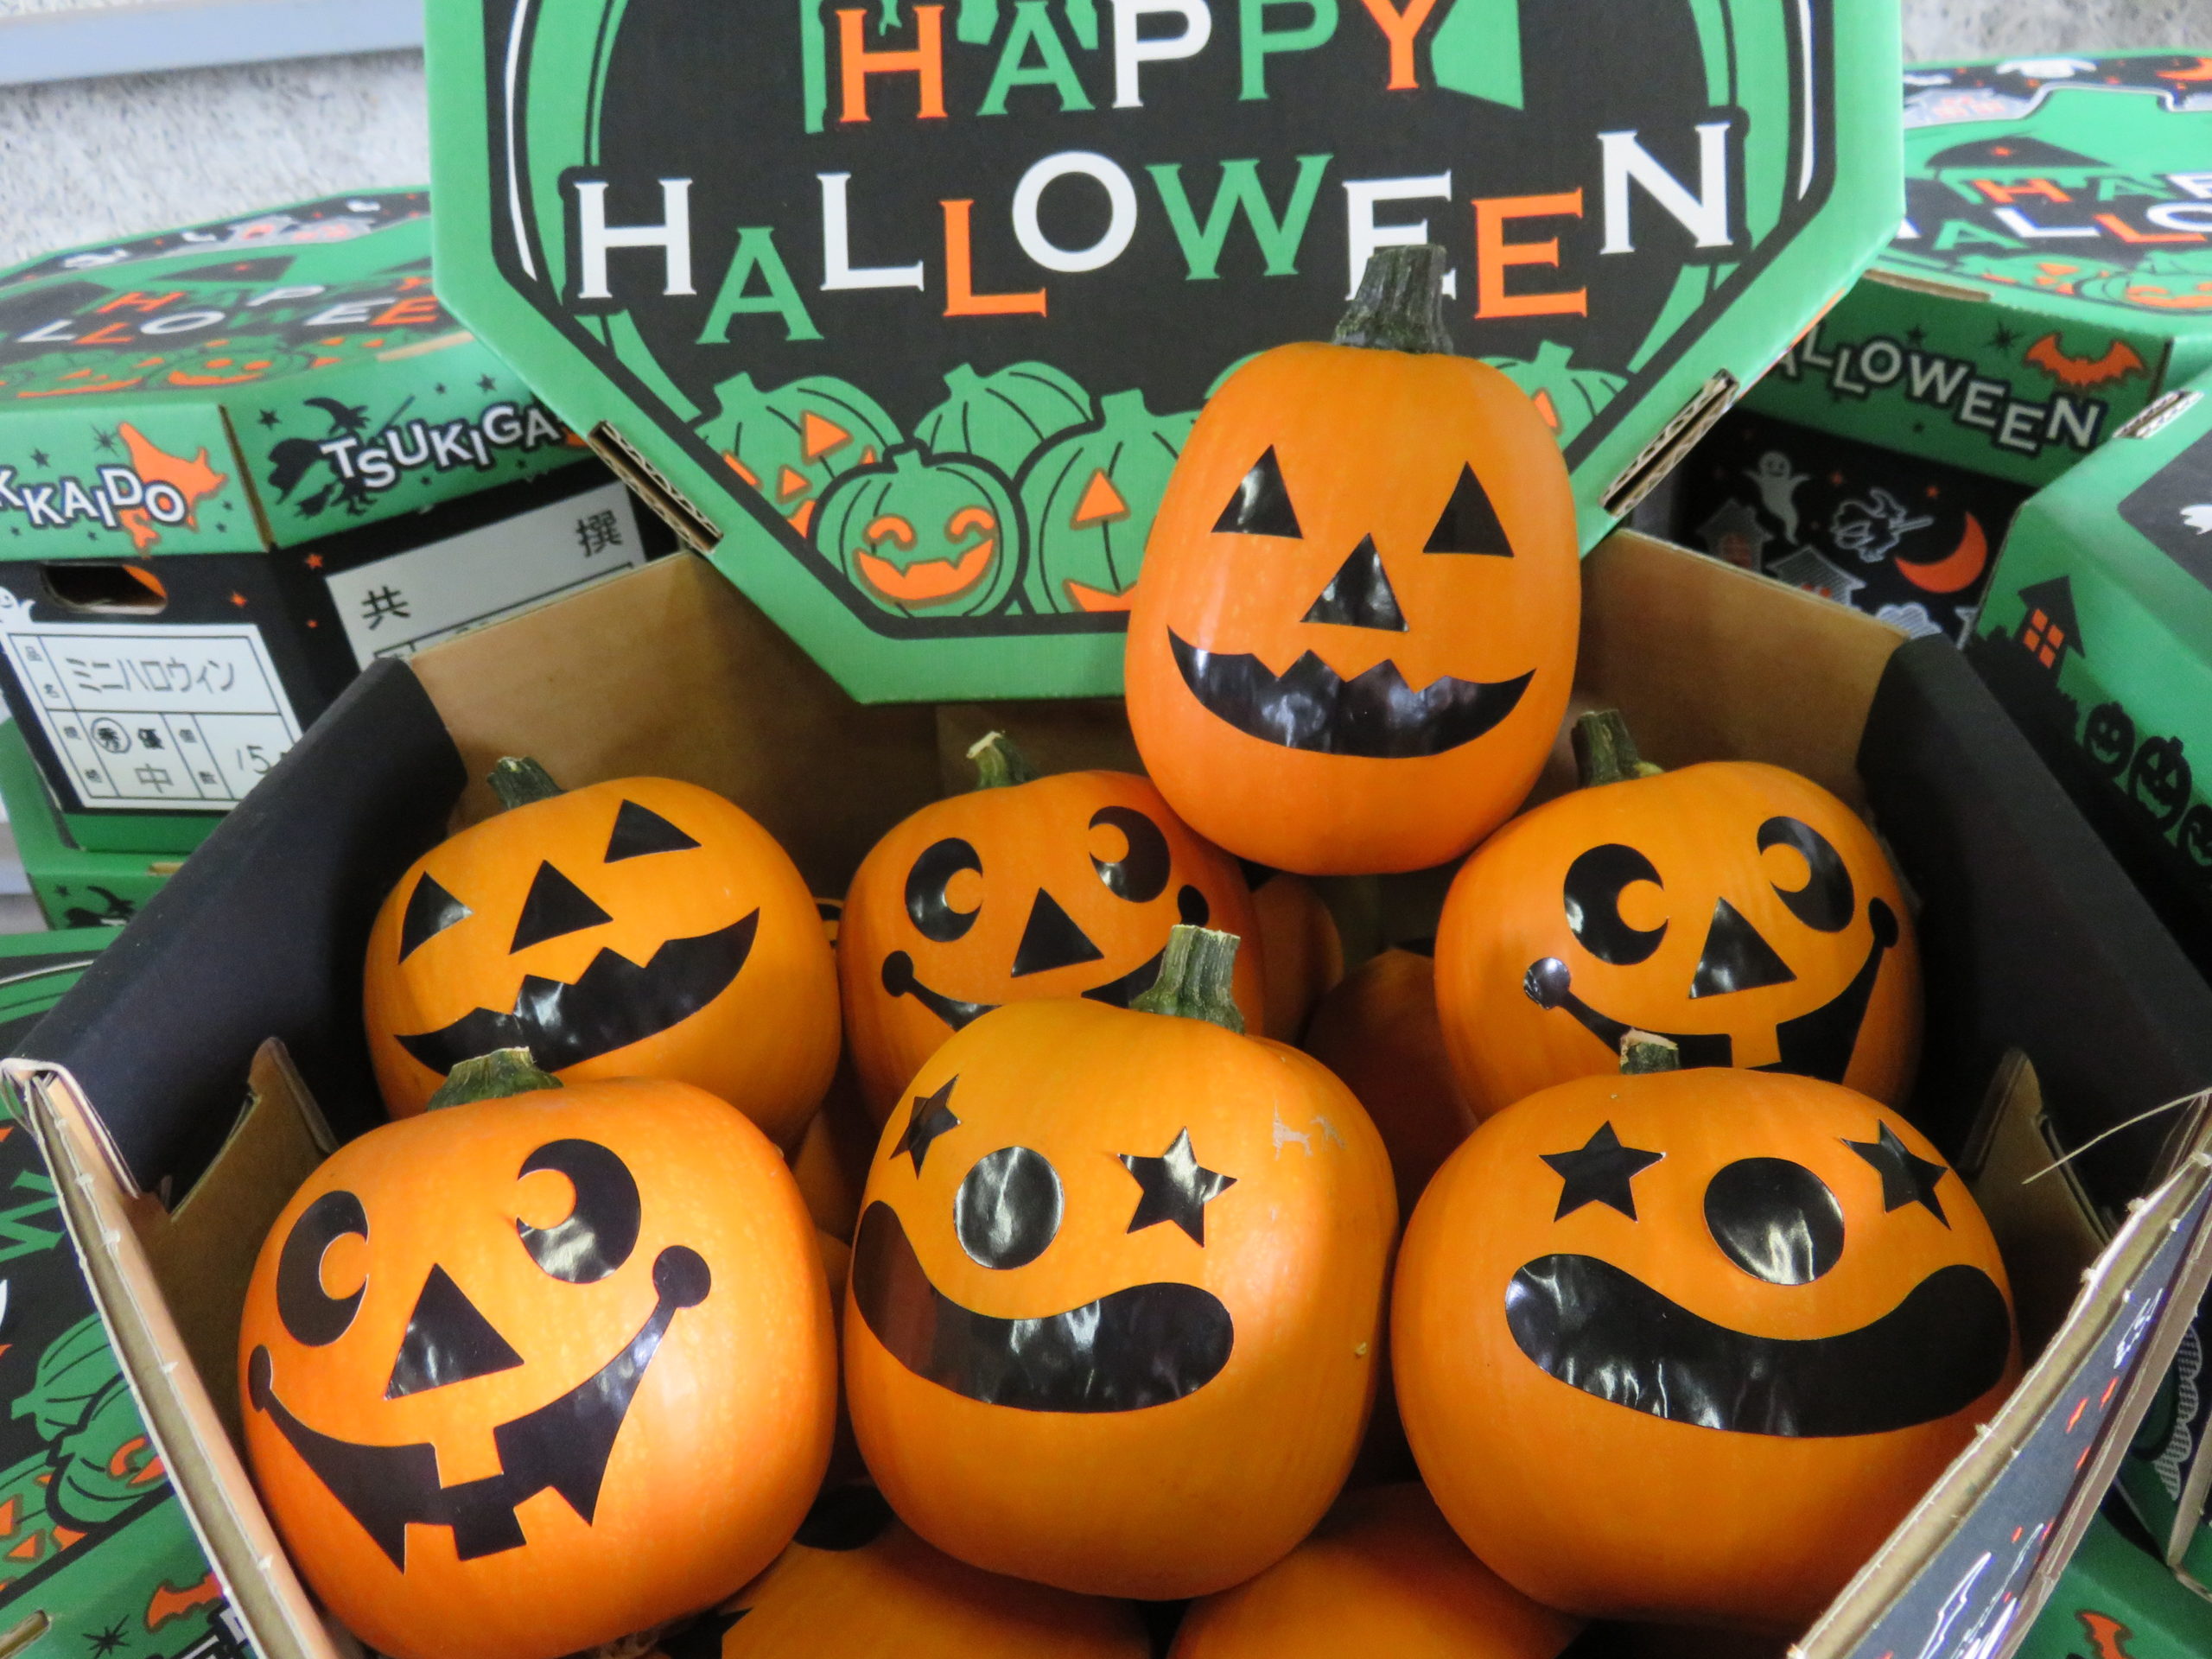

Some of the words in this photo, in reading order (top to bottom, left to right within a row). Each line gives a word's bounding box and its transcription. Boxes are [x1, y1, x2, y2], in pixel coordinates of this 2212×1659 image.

[837, 0, 1436, 123] HAPPY
[574, 122, 1733, 344] HALLOWEEN
[321, 404, 562, 489] TSUKIGA
[361, 586, 410, 631] 共
[576, 510, 623, 557] 撰
[66, 657, 235, 693] ミニハロウィン
[134, 763, 175, 793] 中
